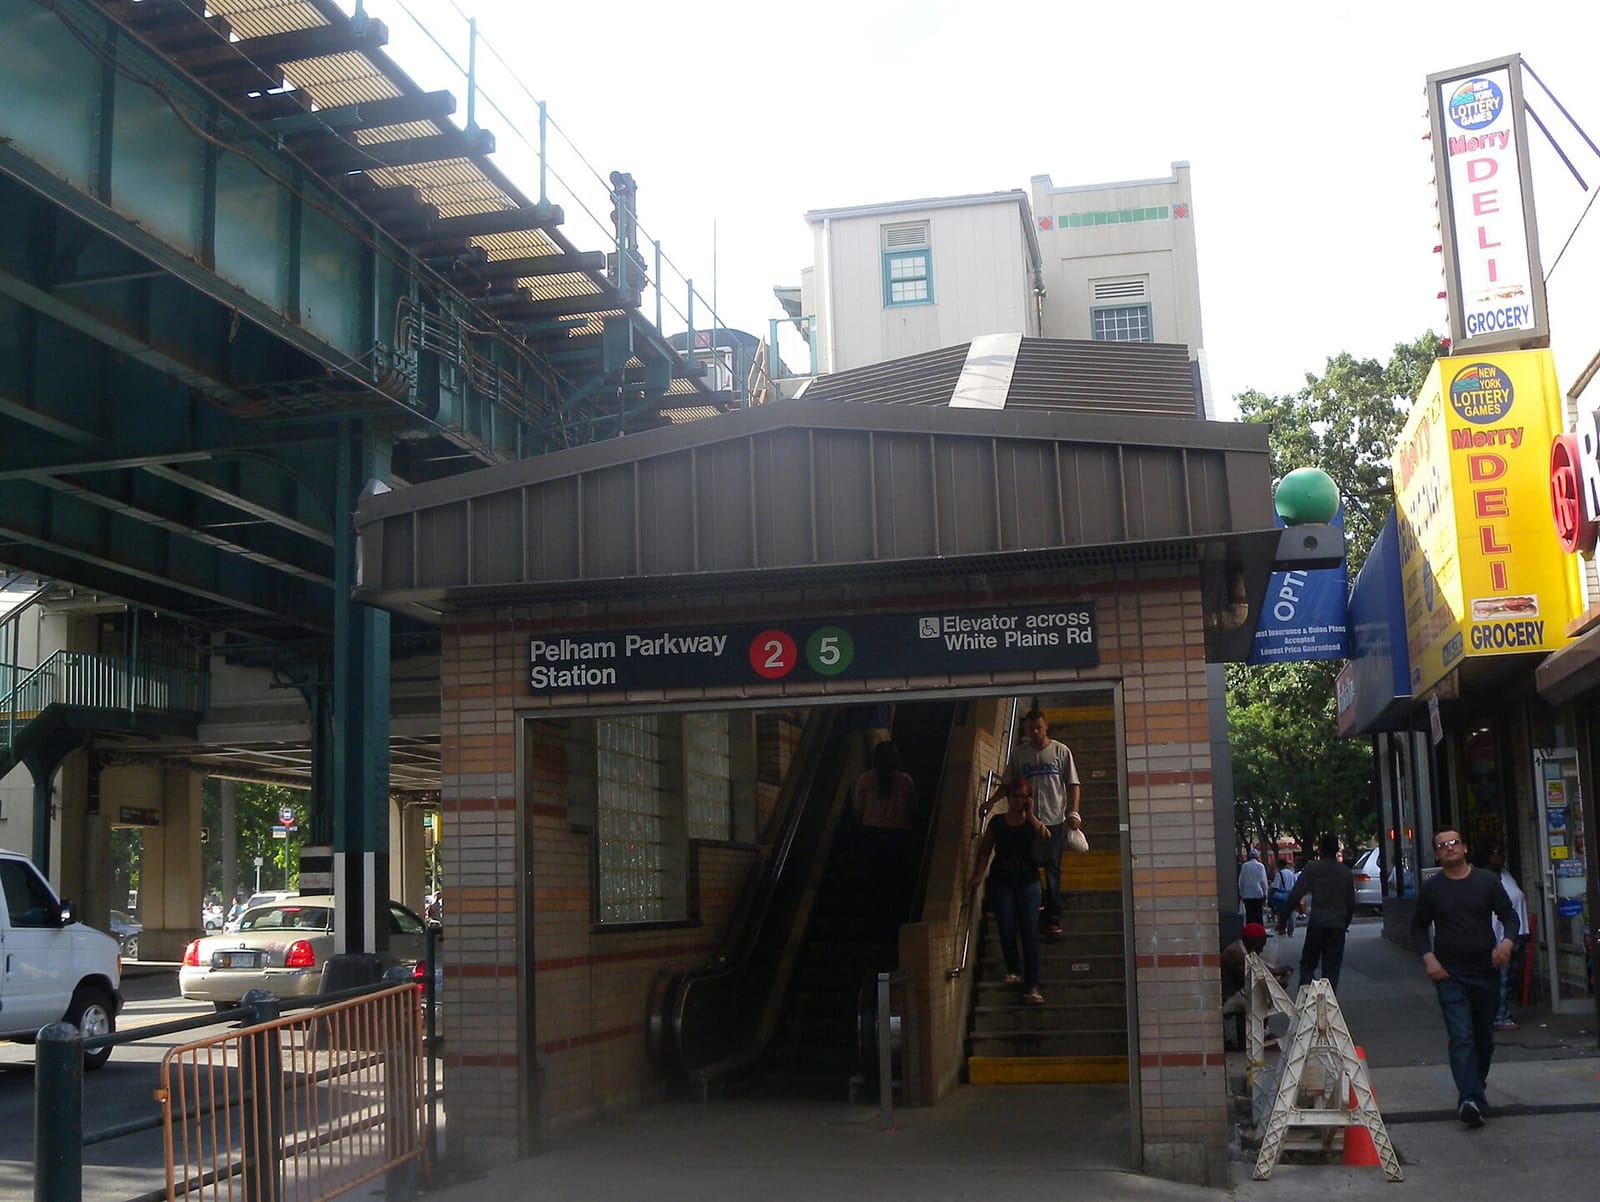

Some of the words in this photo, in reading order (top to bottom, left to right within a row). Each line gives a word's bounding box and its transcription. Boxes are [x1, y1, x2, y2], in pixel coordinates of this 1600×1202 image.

[1451, 97, 1500, 119] LOTTERY
[1460, 111, 1493, 126] GAMES
[1448, 129, 1510, 157] Merry
[1467, 157, 1502, 282] DELI
[1467, 304, 1529, 334] GROCERY
[1478, 367, 1496, 378] NEW
[1480, 378, 1501, 390] YORK
[1453, 388, 1510, 407] LOTTERY
[1464, 403, 1502, 417] GAMES
[1450, 426, 1524, 450] Merry
[1468, 453, 1511, 592] DELI
[943, 614, 1018, 632] Elevator
[1025, 611, 1090, 628] across
[1268, 627, 1302, 637] Insurance
[1308, 625, 1328, 634] Union
[1328, 625, 1346, 633] Plans
[944, 633, 998, 650] White
[1004, 630, 1059, 647] Plains
[1066, 627, 1092, 644] Rd
[1284, 635, 1316, 645] Accepted
[1470, 620, 1545, 650] GROCERY
[530, 638, 616, 662] Pelham
[625, 632, 728, 657] Parkway
[764, 640, 784, 668] 2
[819, 637, 840, 665] 5
[1261, 646, 1284, 656] Lowest
[1284, 644, 1302, 654] Price
[1302, 642, 1341, 652] Guaranteed
[531, 664, 616, 688] Station
